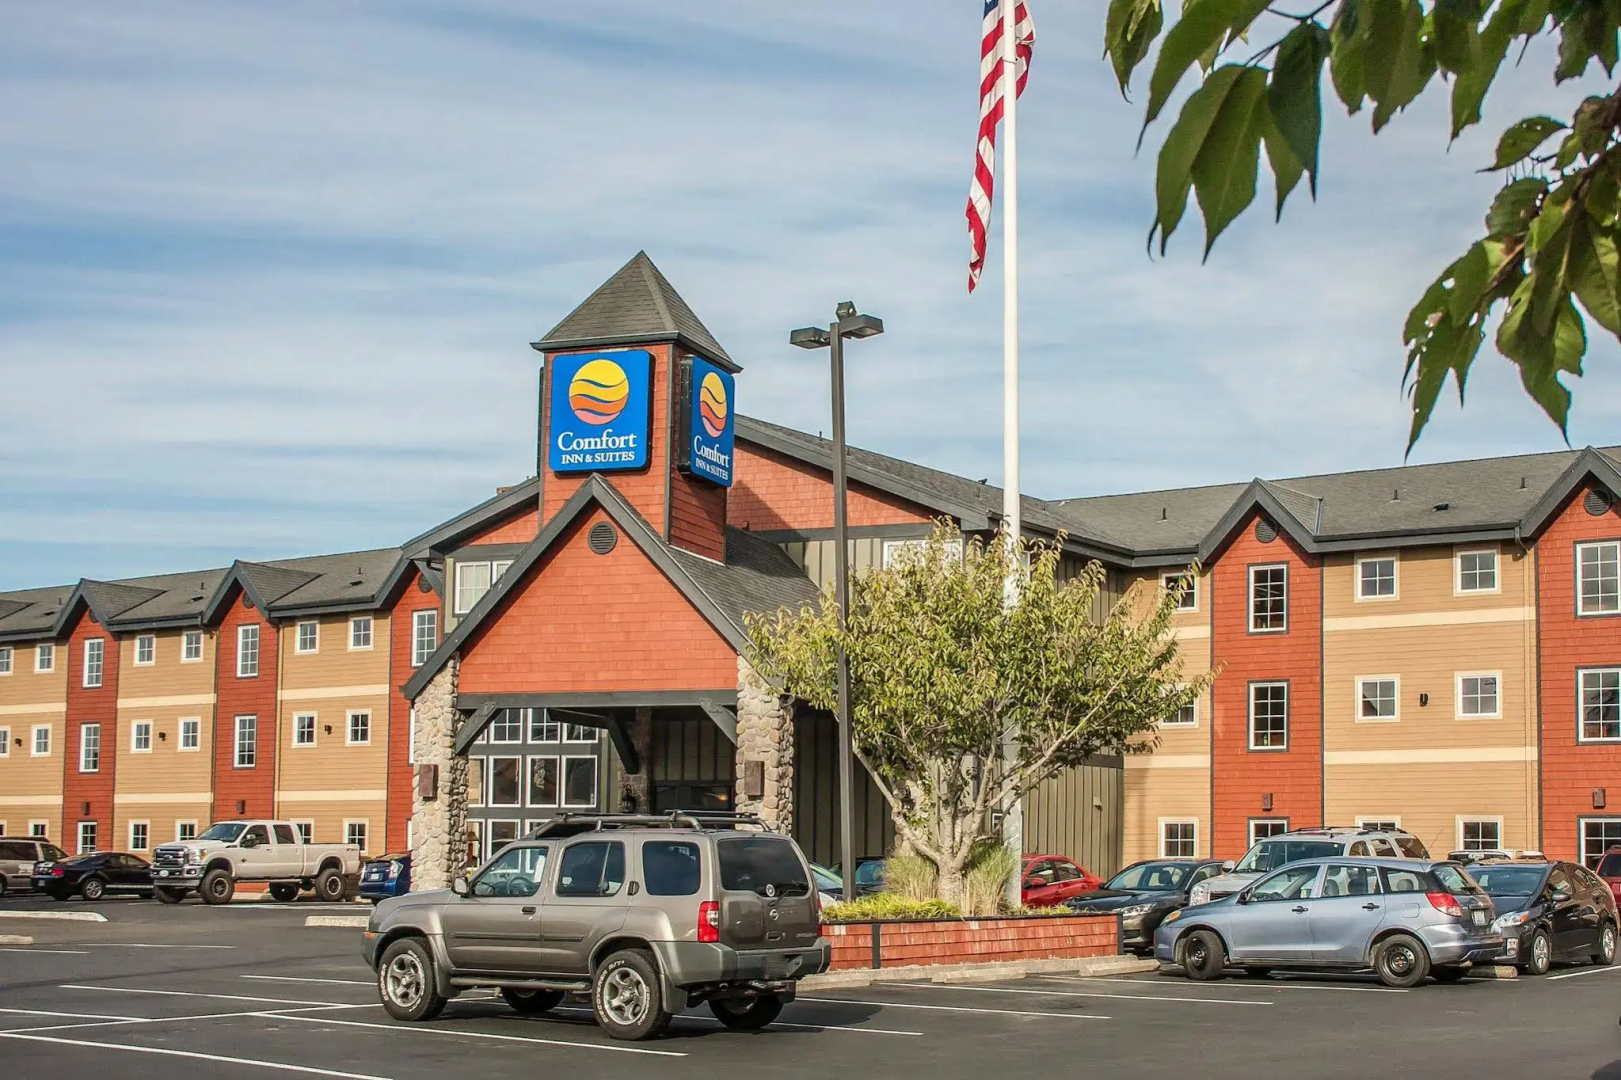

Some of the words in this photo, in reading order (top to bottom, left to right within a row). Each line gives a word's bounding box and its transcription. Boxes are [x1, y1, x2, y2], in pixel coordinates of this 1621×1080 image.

[557, 428, 637, 451] Comfort
[561, 453, 583, 464] INN
[585, 454, 593, 463] &
[594, 451, 635, 463] SUITES
[693, 435, 730, 468] Comfort
[695, 457, 707, 470] INN
[710, 465, 729, 480] SUITES
